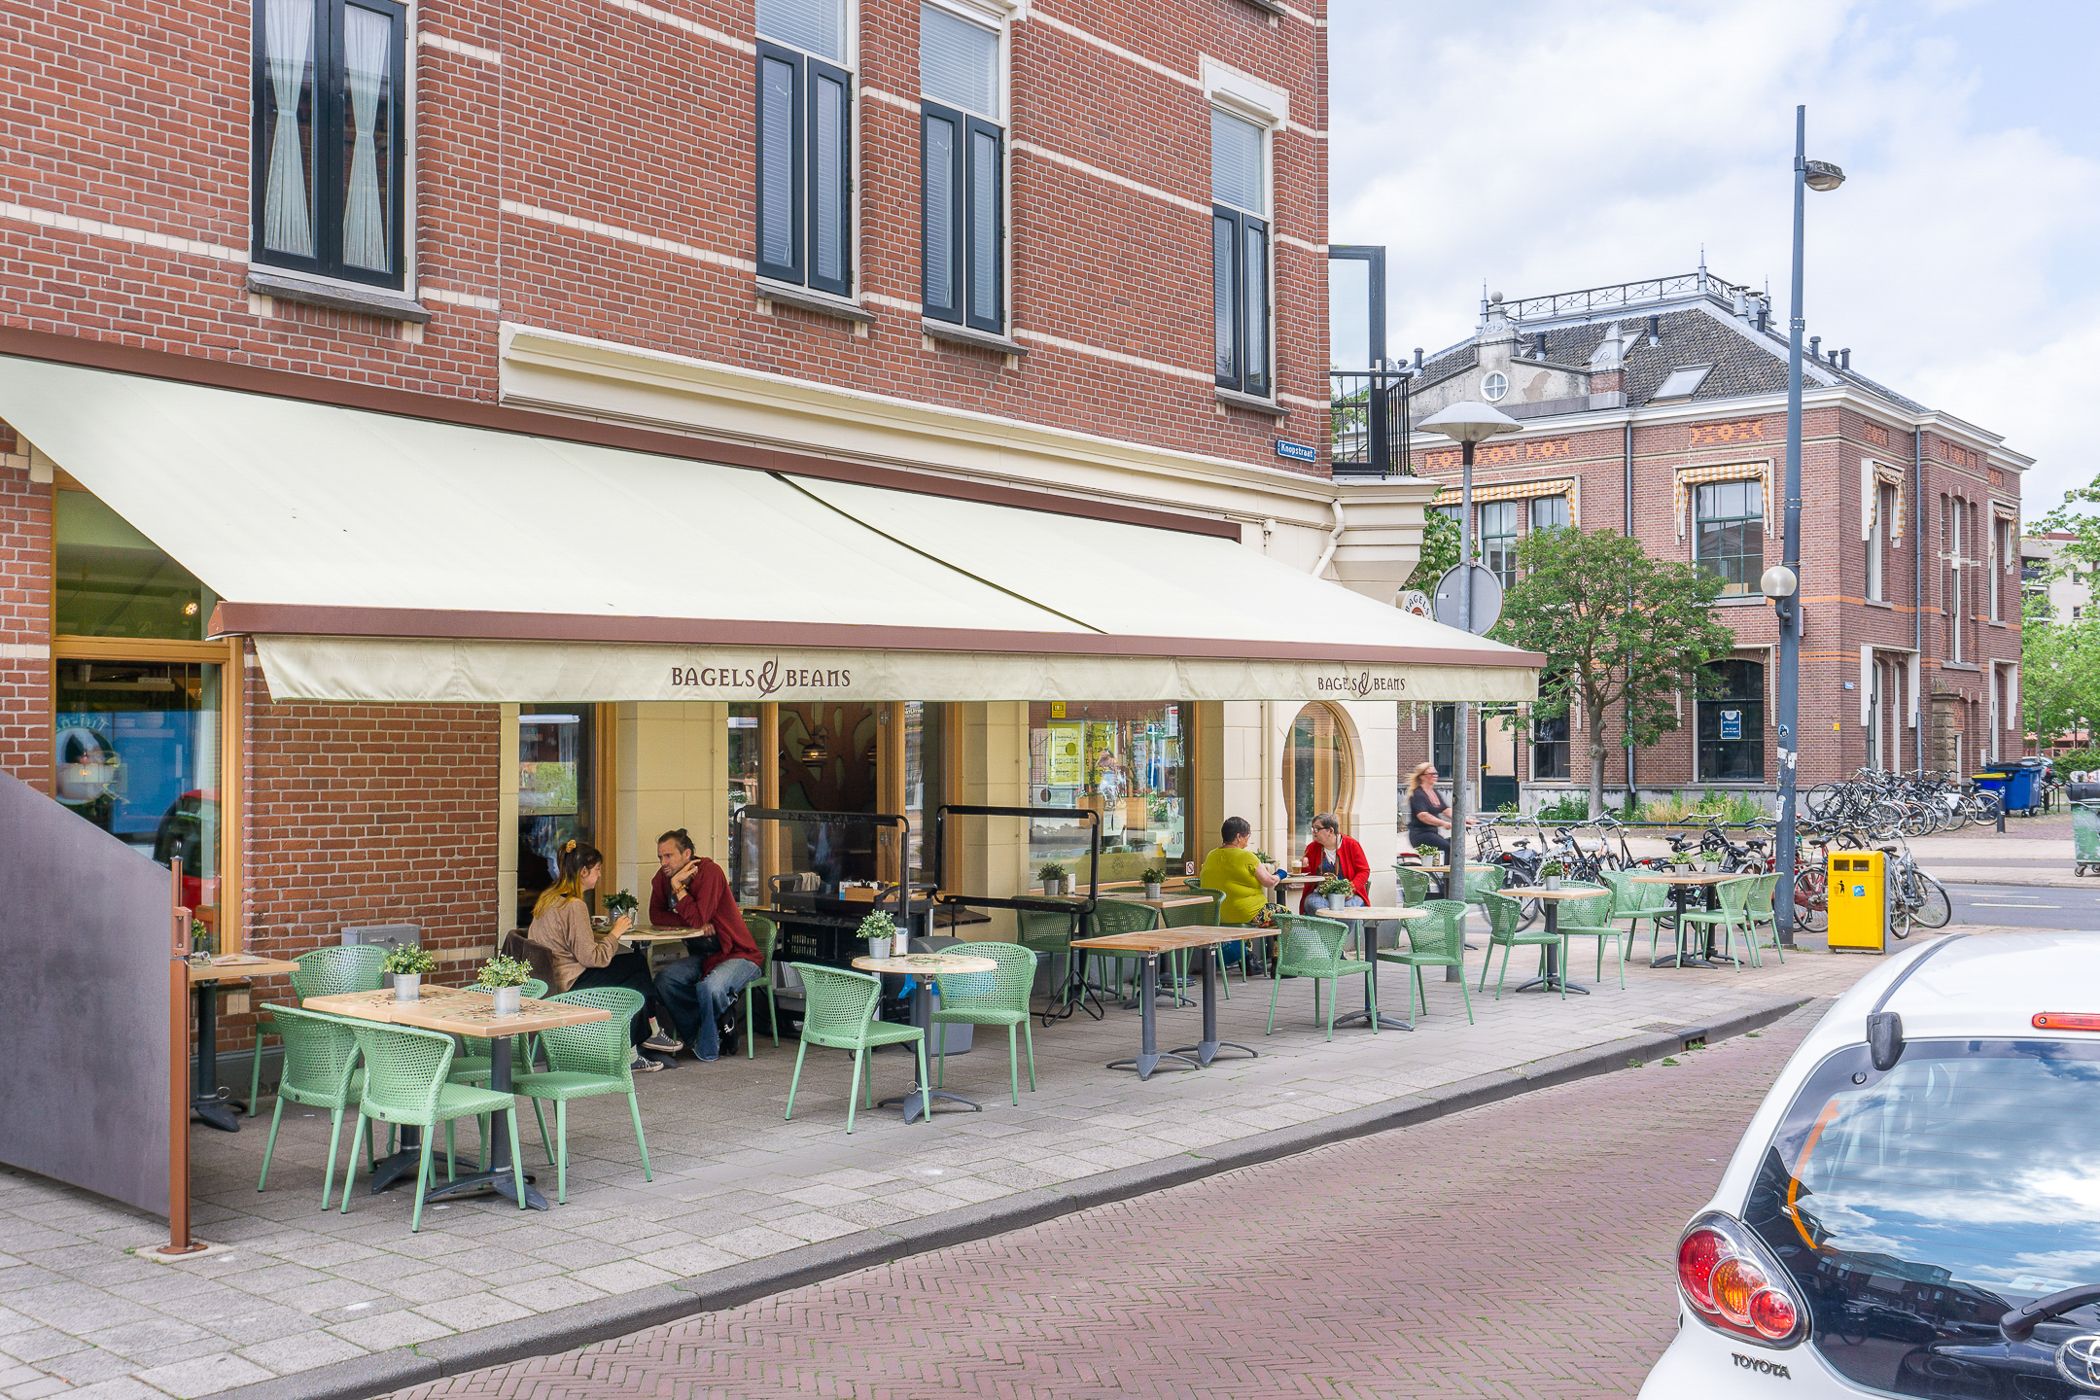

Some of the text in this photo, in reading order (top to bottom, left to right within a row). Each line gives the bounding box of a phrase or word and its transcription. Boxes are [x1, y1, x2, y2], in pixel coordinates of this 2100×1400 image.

[1280, 443, 1313, 458] Knopstraat
[1405, 594, 1430, 615] BAGELS
[671, 653, 851, 699] BAGELS & BEANS
[1358, 667, 1374, 698] &
[1373, 677, 1406, 691] BEANS
[1731, 1352, 1792, 1380] TOYOTA
